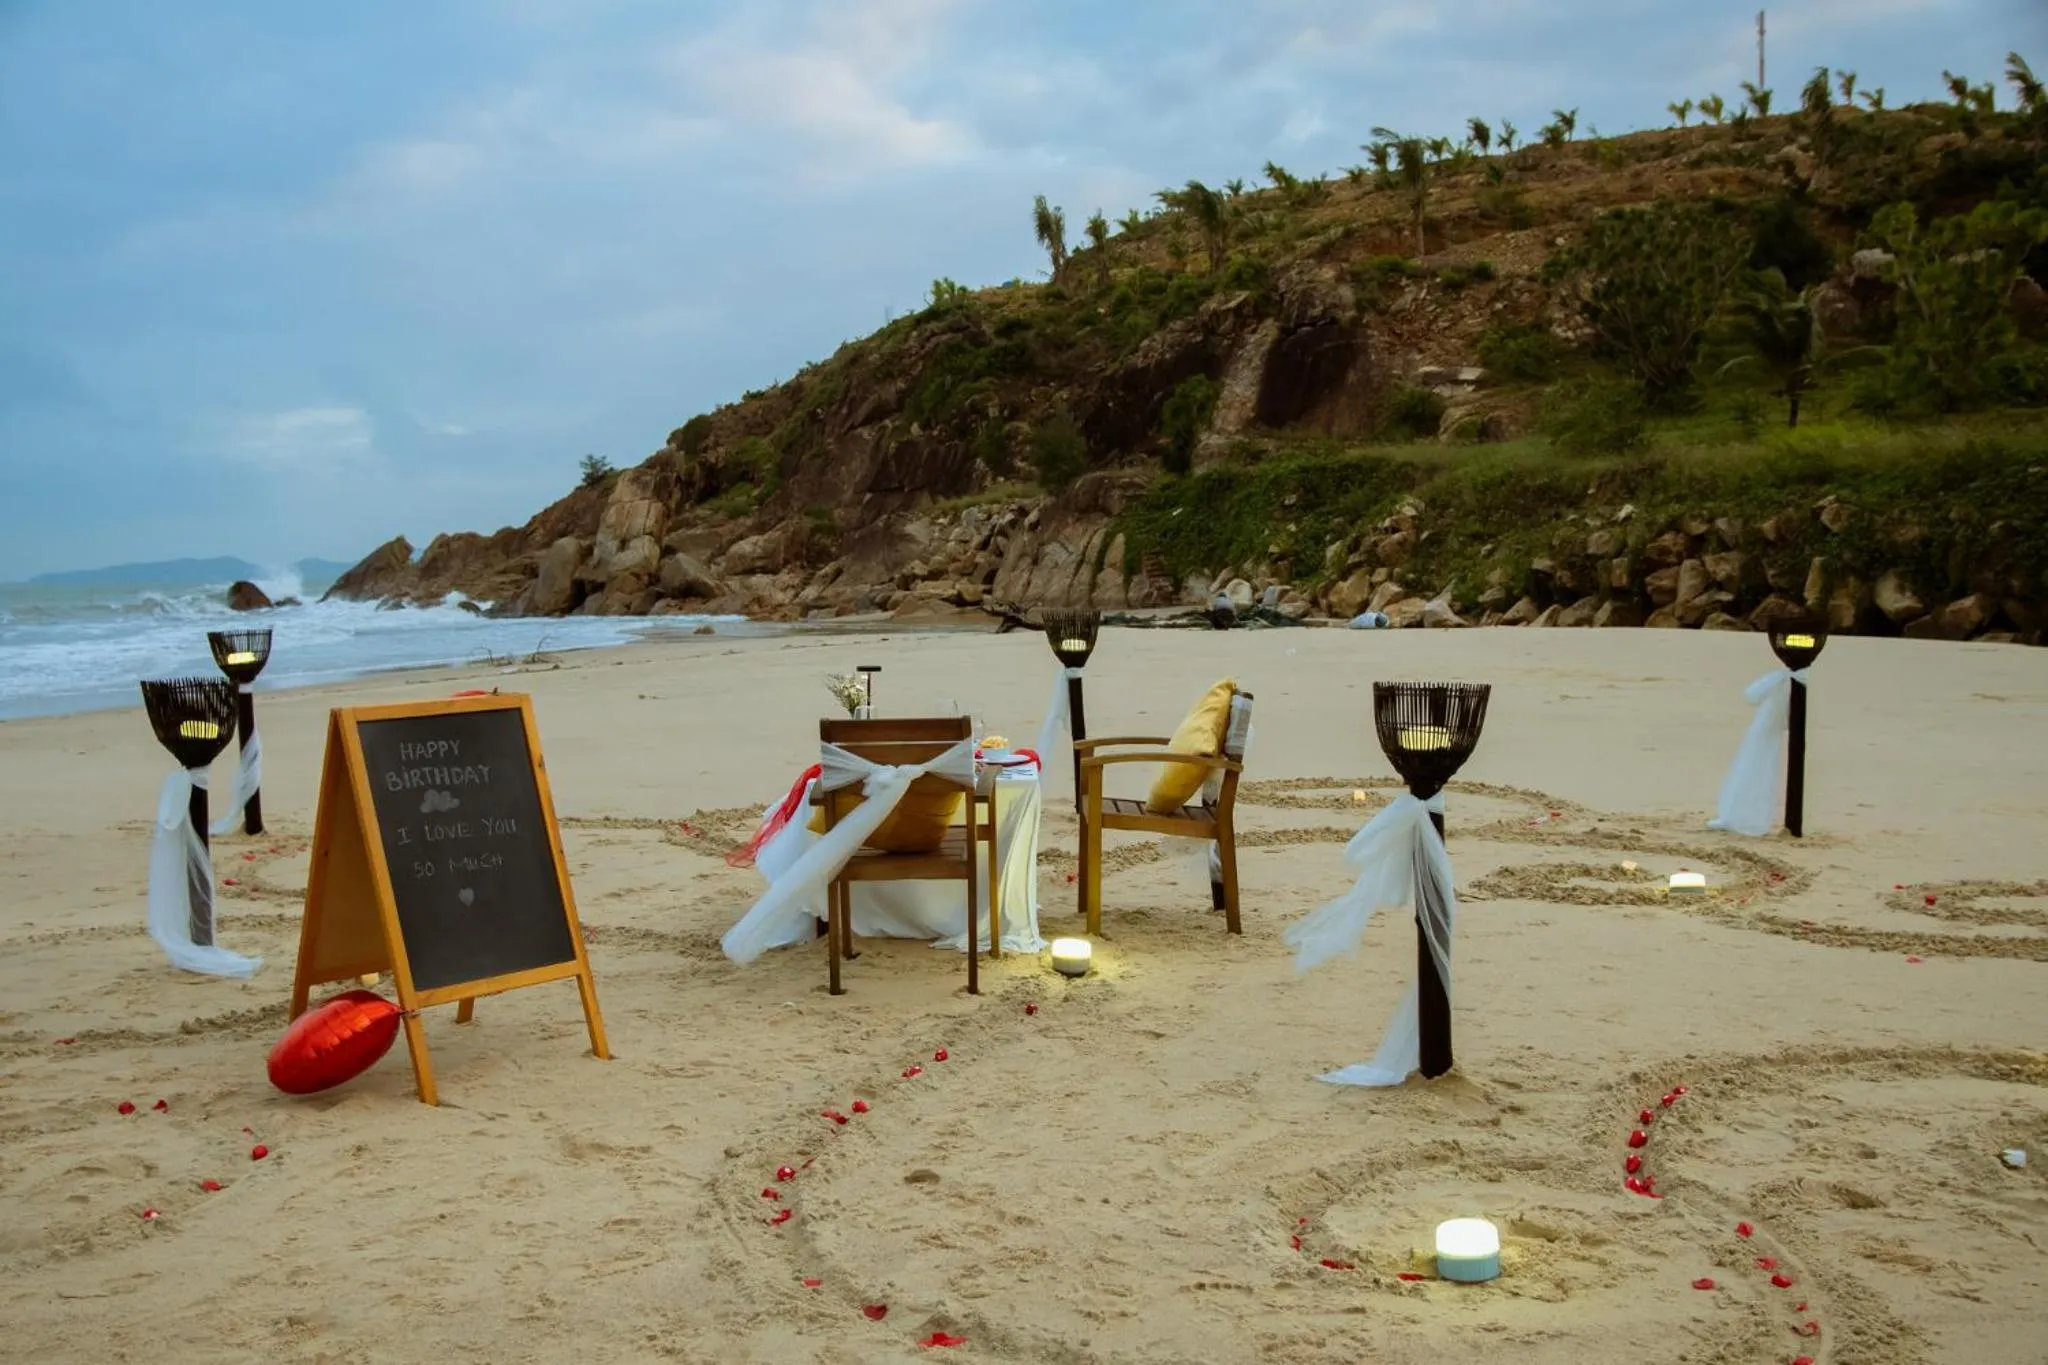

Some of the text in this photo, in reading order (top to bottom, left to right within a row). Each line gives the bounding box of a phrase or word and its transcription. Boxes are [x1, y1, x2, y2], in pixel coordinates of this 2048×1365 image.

[400, 740, 460, 761] HAPPY
[397, 816, 517, 845] I LOVE YOU
[412, 853, 504, 878] SO MUCH
